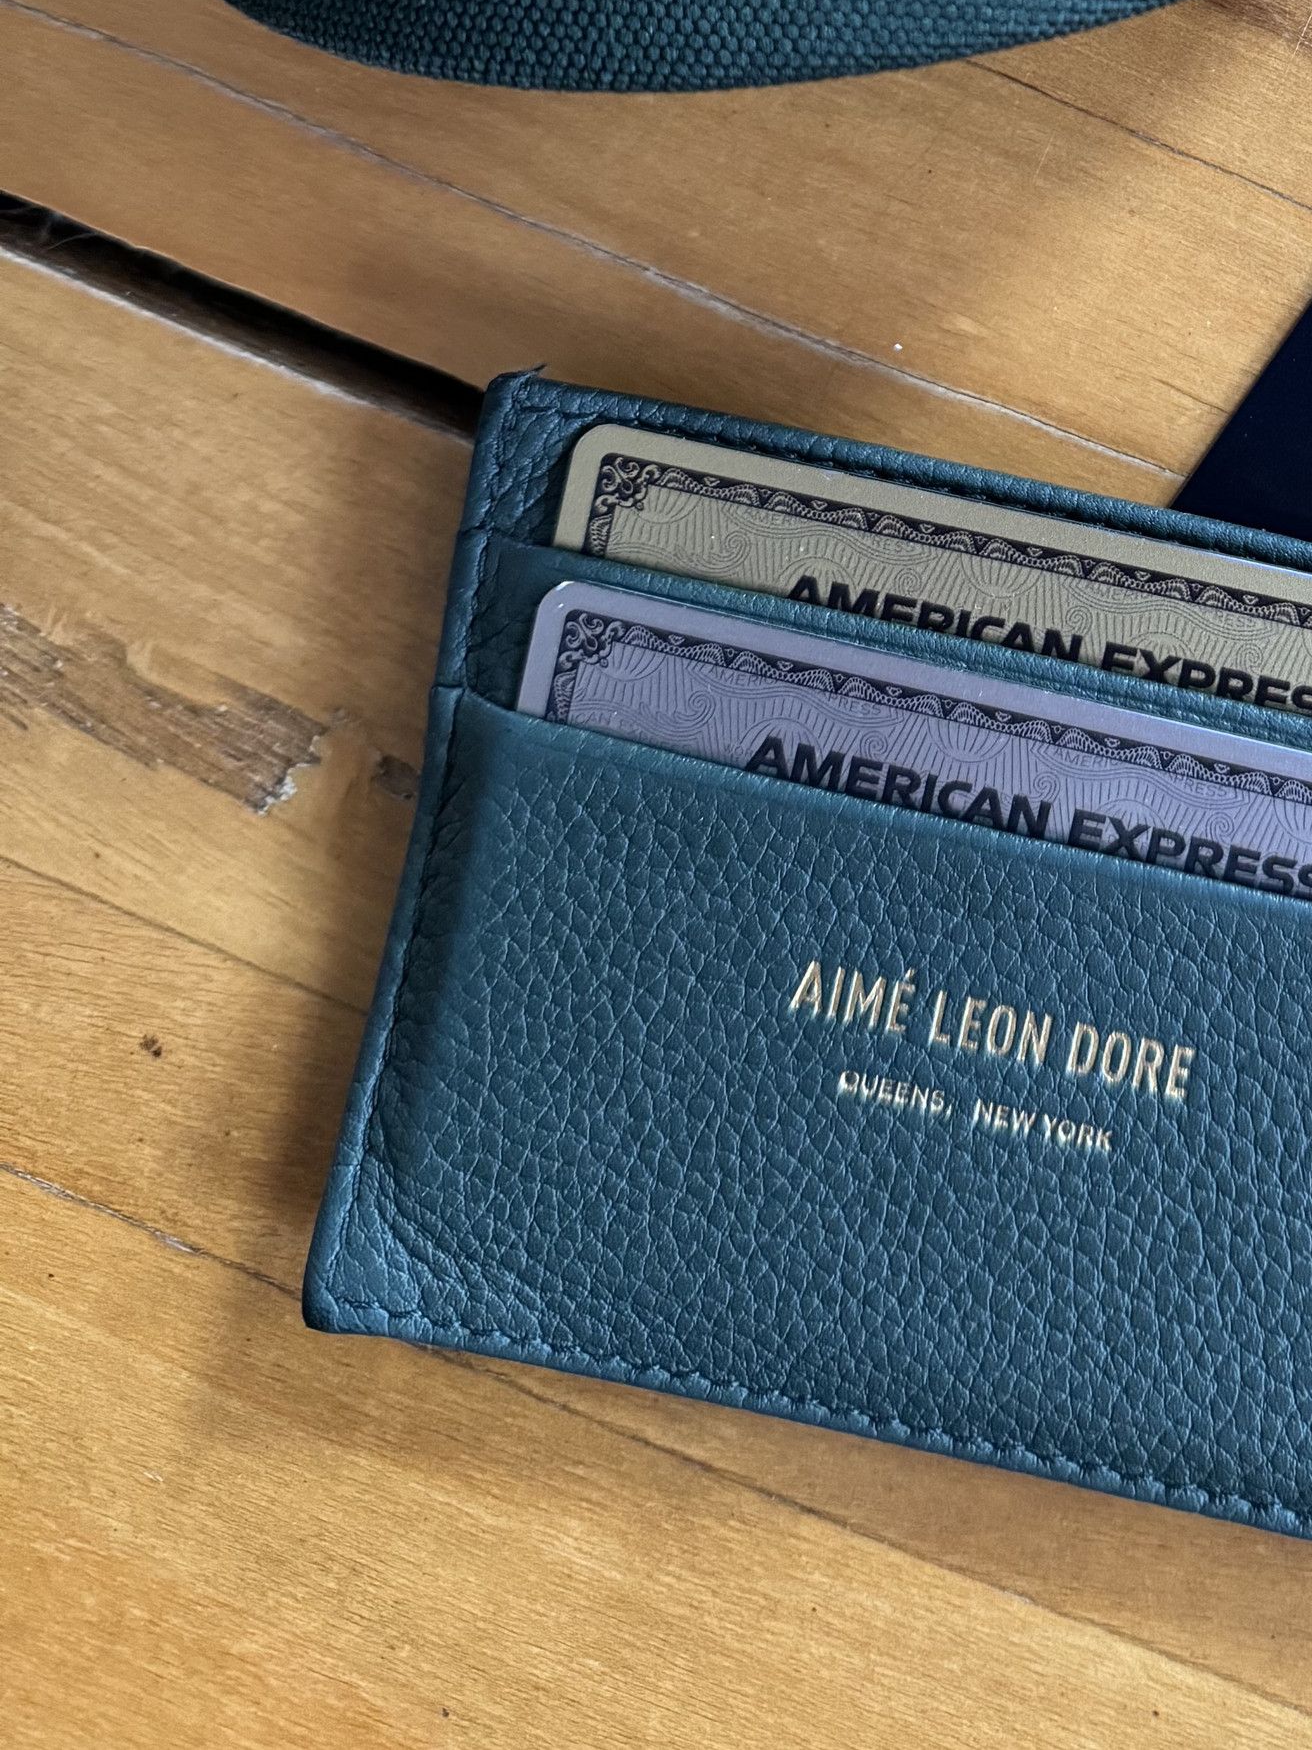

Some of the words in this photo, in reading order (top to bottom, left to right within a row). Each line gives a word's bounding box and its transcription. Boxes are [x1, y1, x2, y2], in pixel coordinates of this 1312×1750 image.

[787, 575, 1083, 662] AMERICAN
[745, 736, 1050, 838] AMERICAN
[789, 960, 917, 1033] AIMÉ
[930, 990, 1053, 1064] LEON
[1066, 1021, 1196, 1100] DORE
[838, 1070, 953, 1117] QUEENS,
[974, 1098, 1036, 1134] NEW
[1044, 1113, 1113, 1151] YORK
